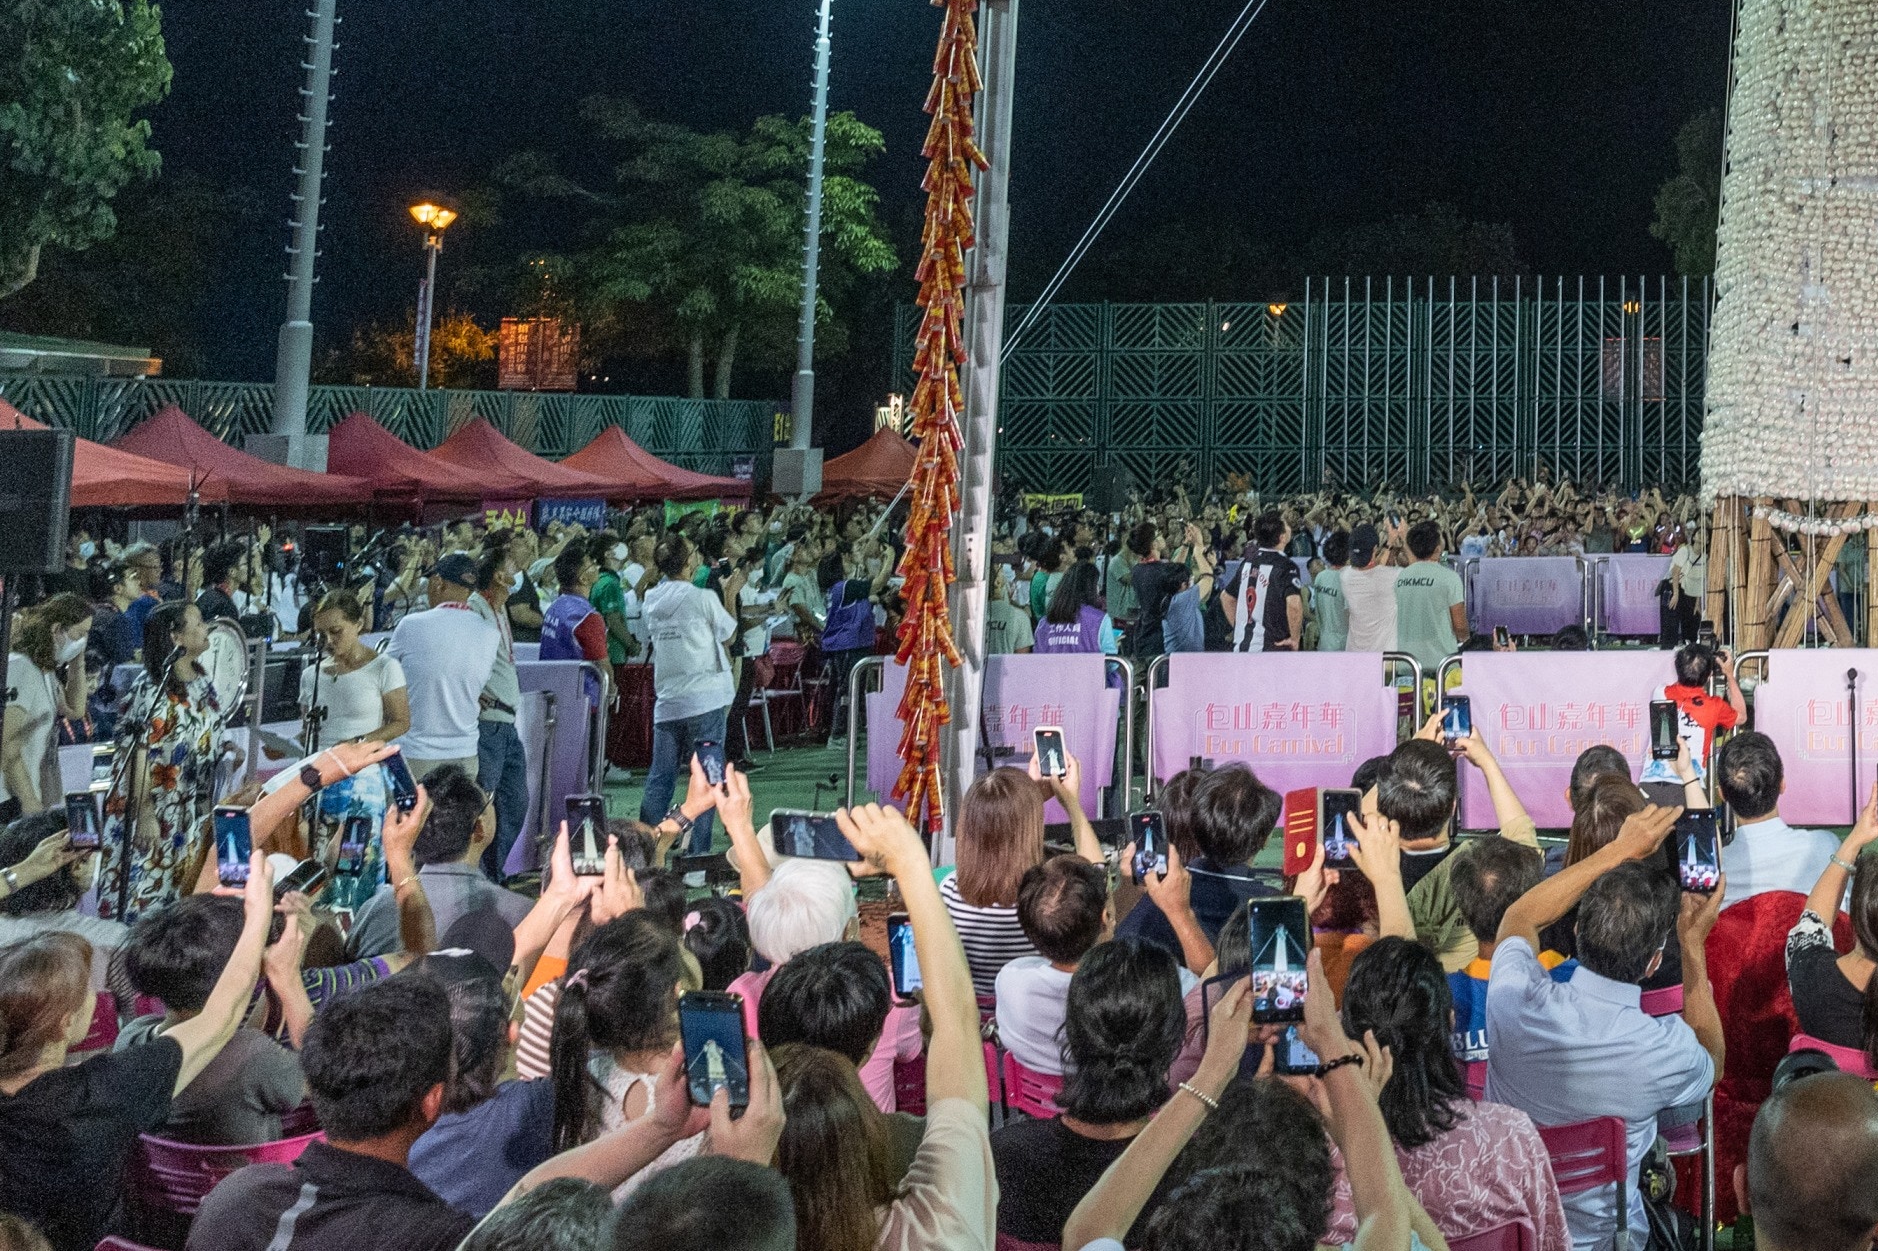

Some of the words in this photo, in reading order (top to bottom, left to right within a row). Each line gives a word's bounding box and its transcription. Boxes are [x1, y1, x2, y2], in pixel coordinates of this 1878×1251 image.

[1048, 635, 1079, 646] OFFICIAL
[1206, 702, 1345, 730] 包山嘉年華
[1500, 702, 1642, 731] 包山嘉年華
[1206, 734, 1247, 755] Bun
[1253, 733, 1344, 755] Carnival
[1501, 734, 1543, 756] Bun
